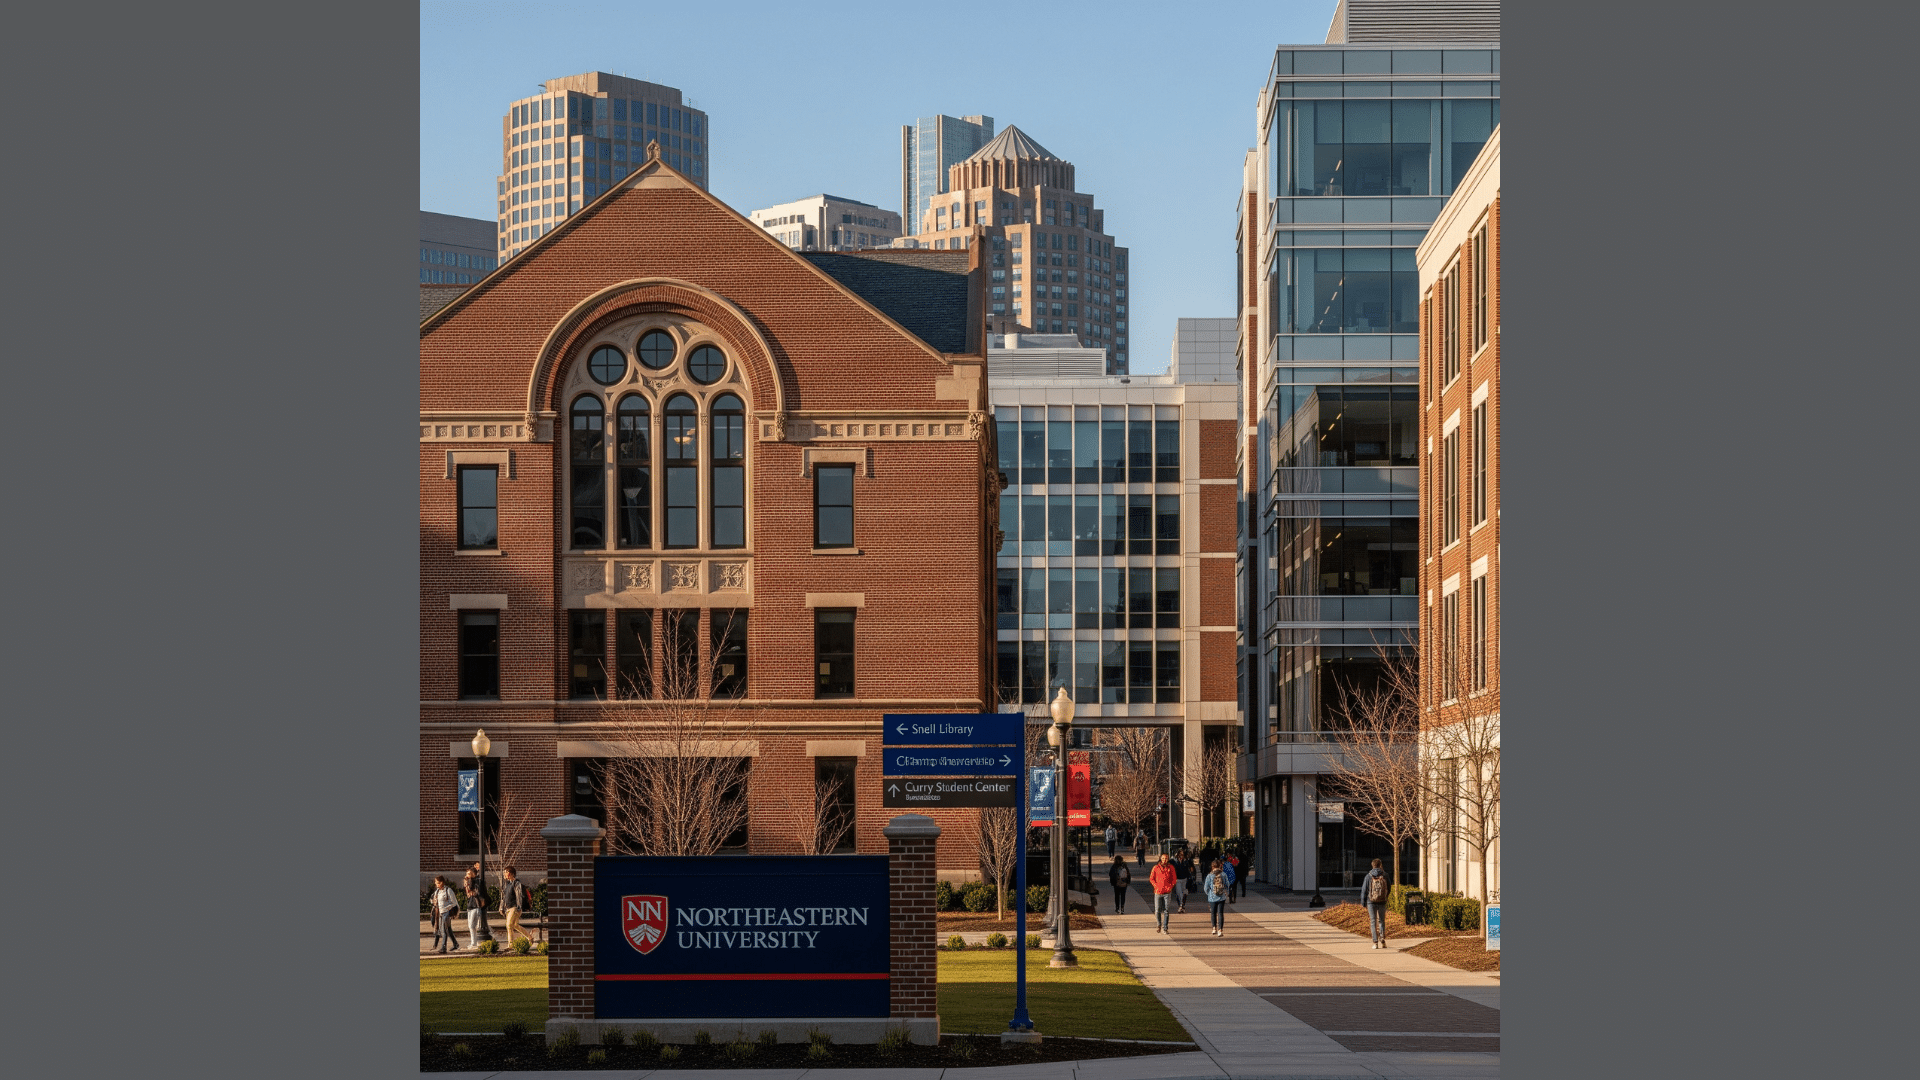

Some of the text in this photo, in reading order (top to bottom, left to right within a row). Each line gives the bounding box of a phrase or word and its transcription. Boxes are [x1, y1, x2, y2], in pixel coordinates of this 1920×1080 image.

[911, 723, 974, 737] Snell Library
[904, 781, 1011, 795] Curry Student Center
[675, 907, 870, 927] NORTHEASTERN
[676, 931, 820, 949] UNIVERSITY
